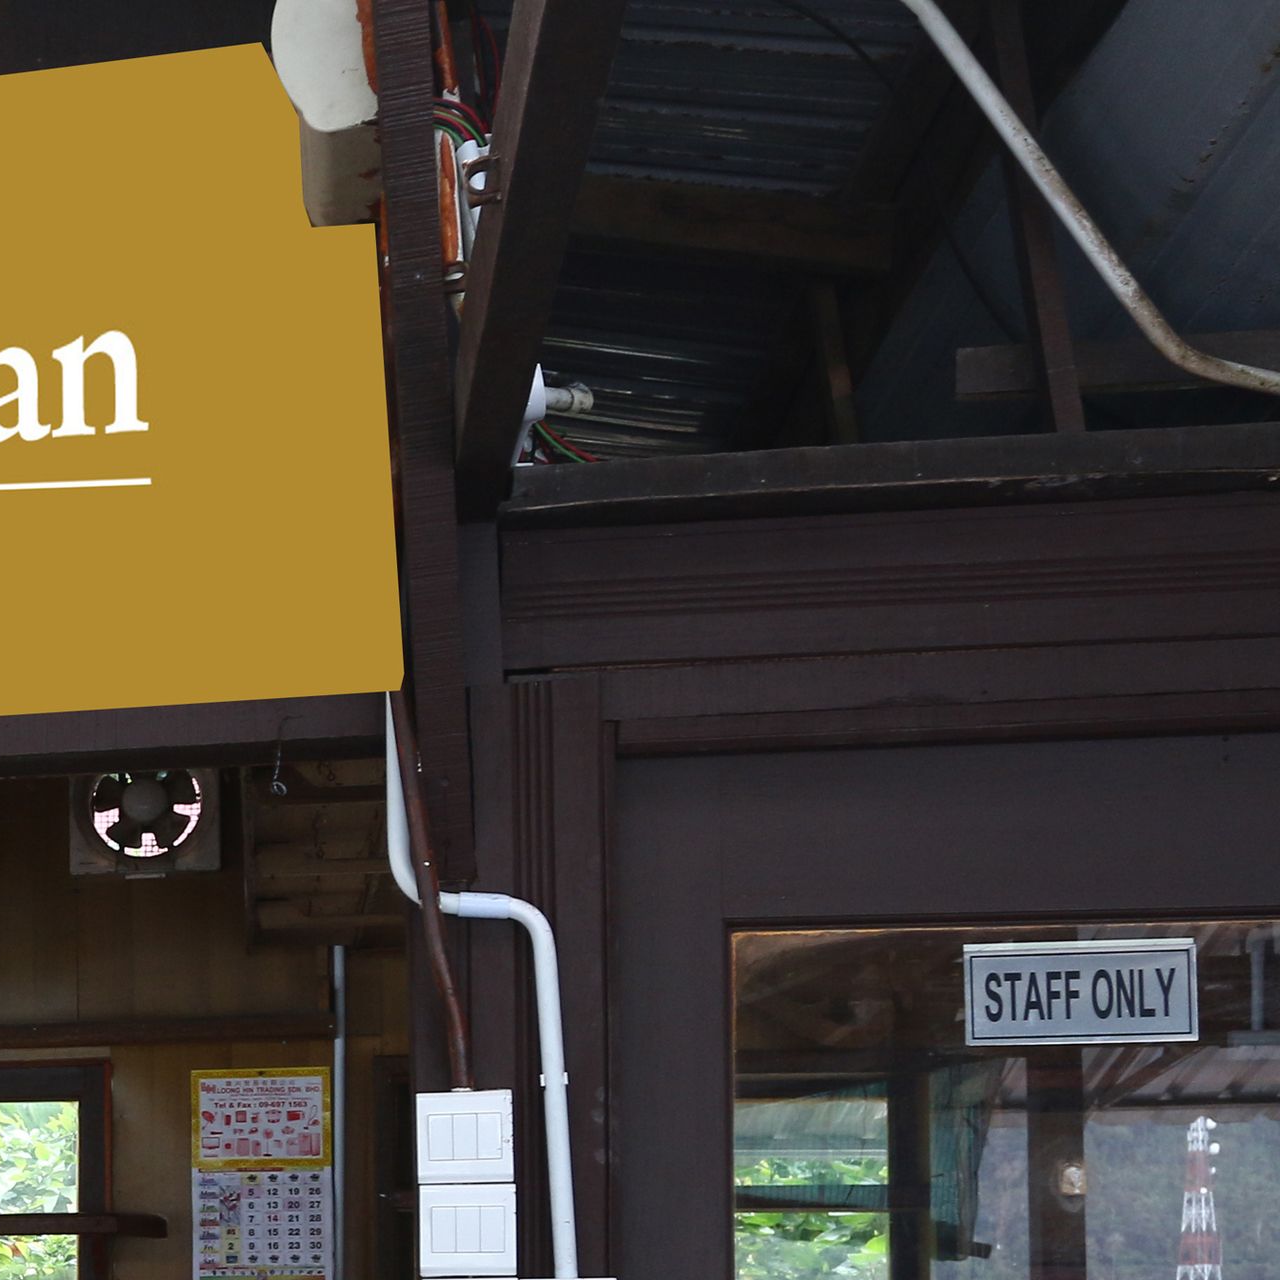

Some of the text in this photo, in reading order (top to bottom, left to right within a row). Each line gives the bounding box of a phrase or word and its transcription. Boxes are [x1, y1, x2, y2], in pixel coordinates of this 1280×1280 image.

[984, 967, 1176, 1023] STAFF ONLY
[248, 1188, 255, 1196] 5
[267, 1188, 279, 1196] 12
[288, 1187, 300, 1195] 19
[309, 1187, 321, 1195] 26
[248, 1201, 255, 1209] 6
[267, 1201, 278, 1209] 13
[288, 1201, 300, 1209] 20
[309, 1200, 321, 1208] 27
[248, 1215, 255, 1223] 7
[267, 1214, 278, 1222] 14
[288, 1214, 299, 1222] 21
[309, 1214, 321, 1222] 28
[248, 1228, 255, 1236] 8
[268, 1228, 279, 1236] 15
[288, 1228, 300, 1236] 22
[310, 1227, 321, 1236] 29
[227, 1242, 234, 1250] 2
[248, 1242, 255, 1250] 9
[268, 1241, 279, 1250] 16
[288, 1241, 301, 1249] 23
[309, 1241, 322, 1249] 30
